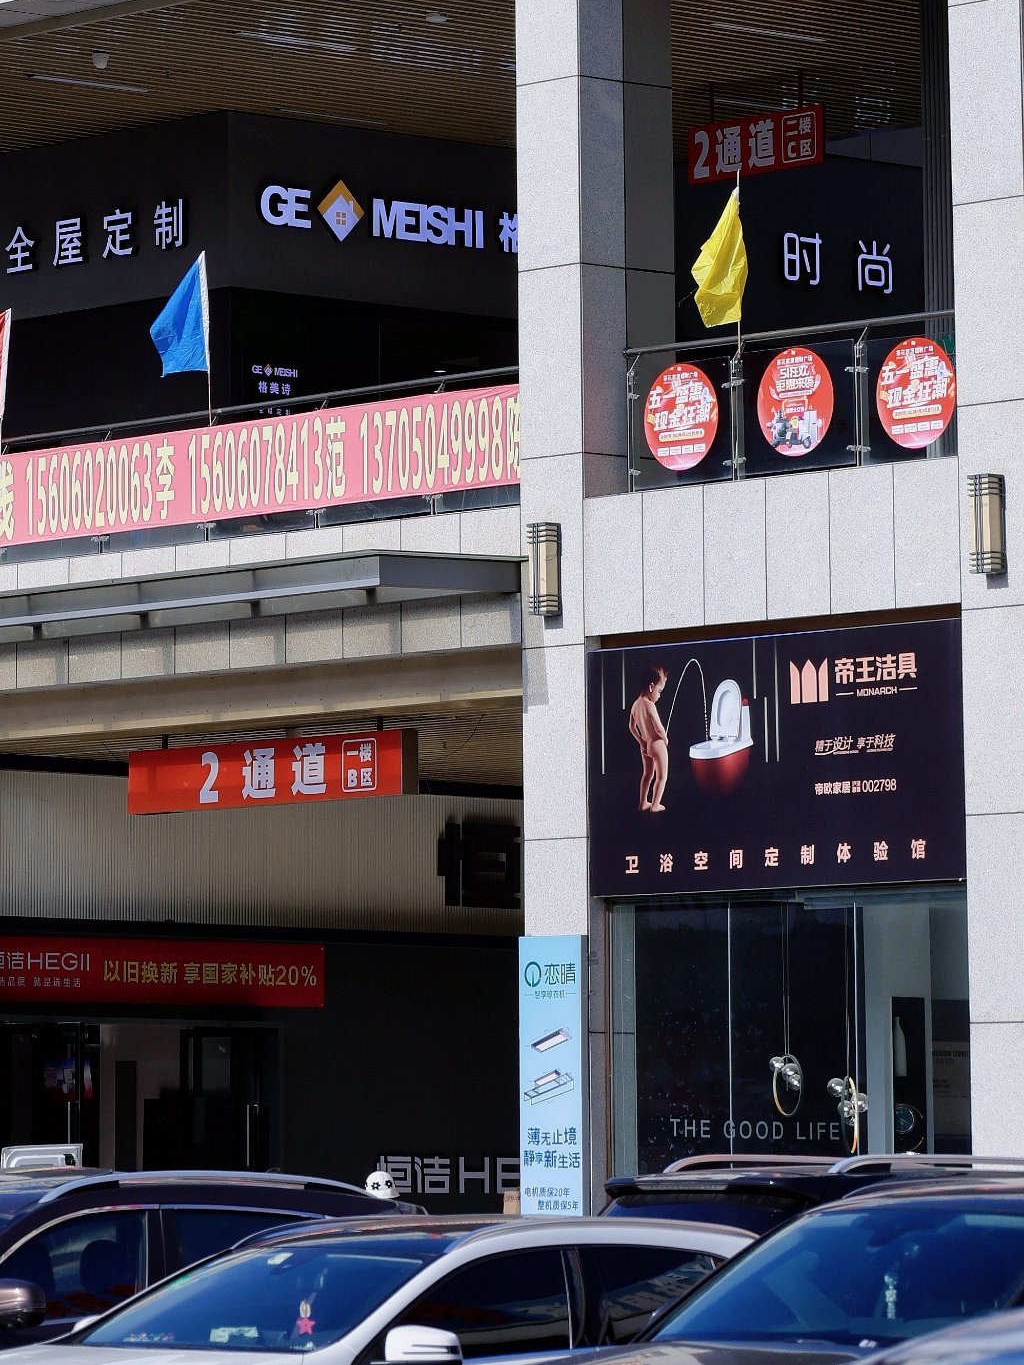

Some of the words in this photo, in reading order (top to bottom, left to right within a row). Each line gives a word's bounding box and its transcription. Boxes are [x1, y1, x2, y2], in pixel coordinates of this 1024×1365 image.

[786, 116, 812, 136] 二楼
[694, 119, 775, 180] 2通道
[787, 138, 812, 158] C区
[260, 185, 312, 229] GE
[372, 198, 484, 249] MEISHI
[5, 198, 184, 275] 全屋定制
[783, 232, 893, 294] 时尚
[887, 377, 949, 409] 现金狂潮
[654, 402, 711, 432] 现金狂潮
[26, 438, 175, 536] 15606020063李
[188, 416, 346, 514] 15606078413范
[834, 652, 917, 684] 帝王洁具
[856, 686, 897, 697] MONARCH
[347, 742, 372, 762] 一楼
[815, 736, 854, 753] 精于设计
[857, 733, 896, 750] 享于科技
[200, 742, 326, 804] 2通道
[347, 767, 373, 787] B区
[815, 781, 851, 795] 帝欧家居
[862, 778, 897, 793] 002798
[625, 839, 927, 874] 卫浴空间定制体验馆
[104, 960, 177, 984] 以旧换新
[183, 962, 317, 986] 享国家补贴20%
[544, 962, 576, 985] 恋晴
[527, 1126, 577, 1145] 薄无止境
[670, 1118, 711, 1138] THE
[723, 1120, 784, 1140] GOOD
[796, 1122, 840, 1140] LIFE
[524, 1149, 580, 1169] 静享新生活
[525, 1186, 570, 1198] 电机质保20年
[537, 1199, 579, 1211] 整机质保5年
